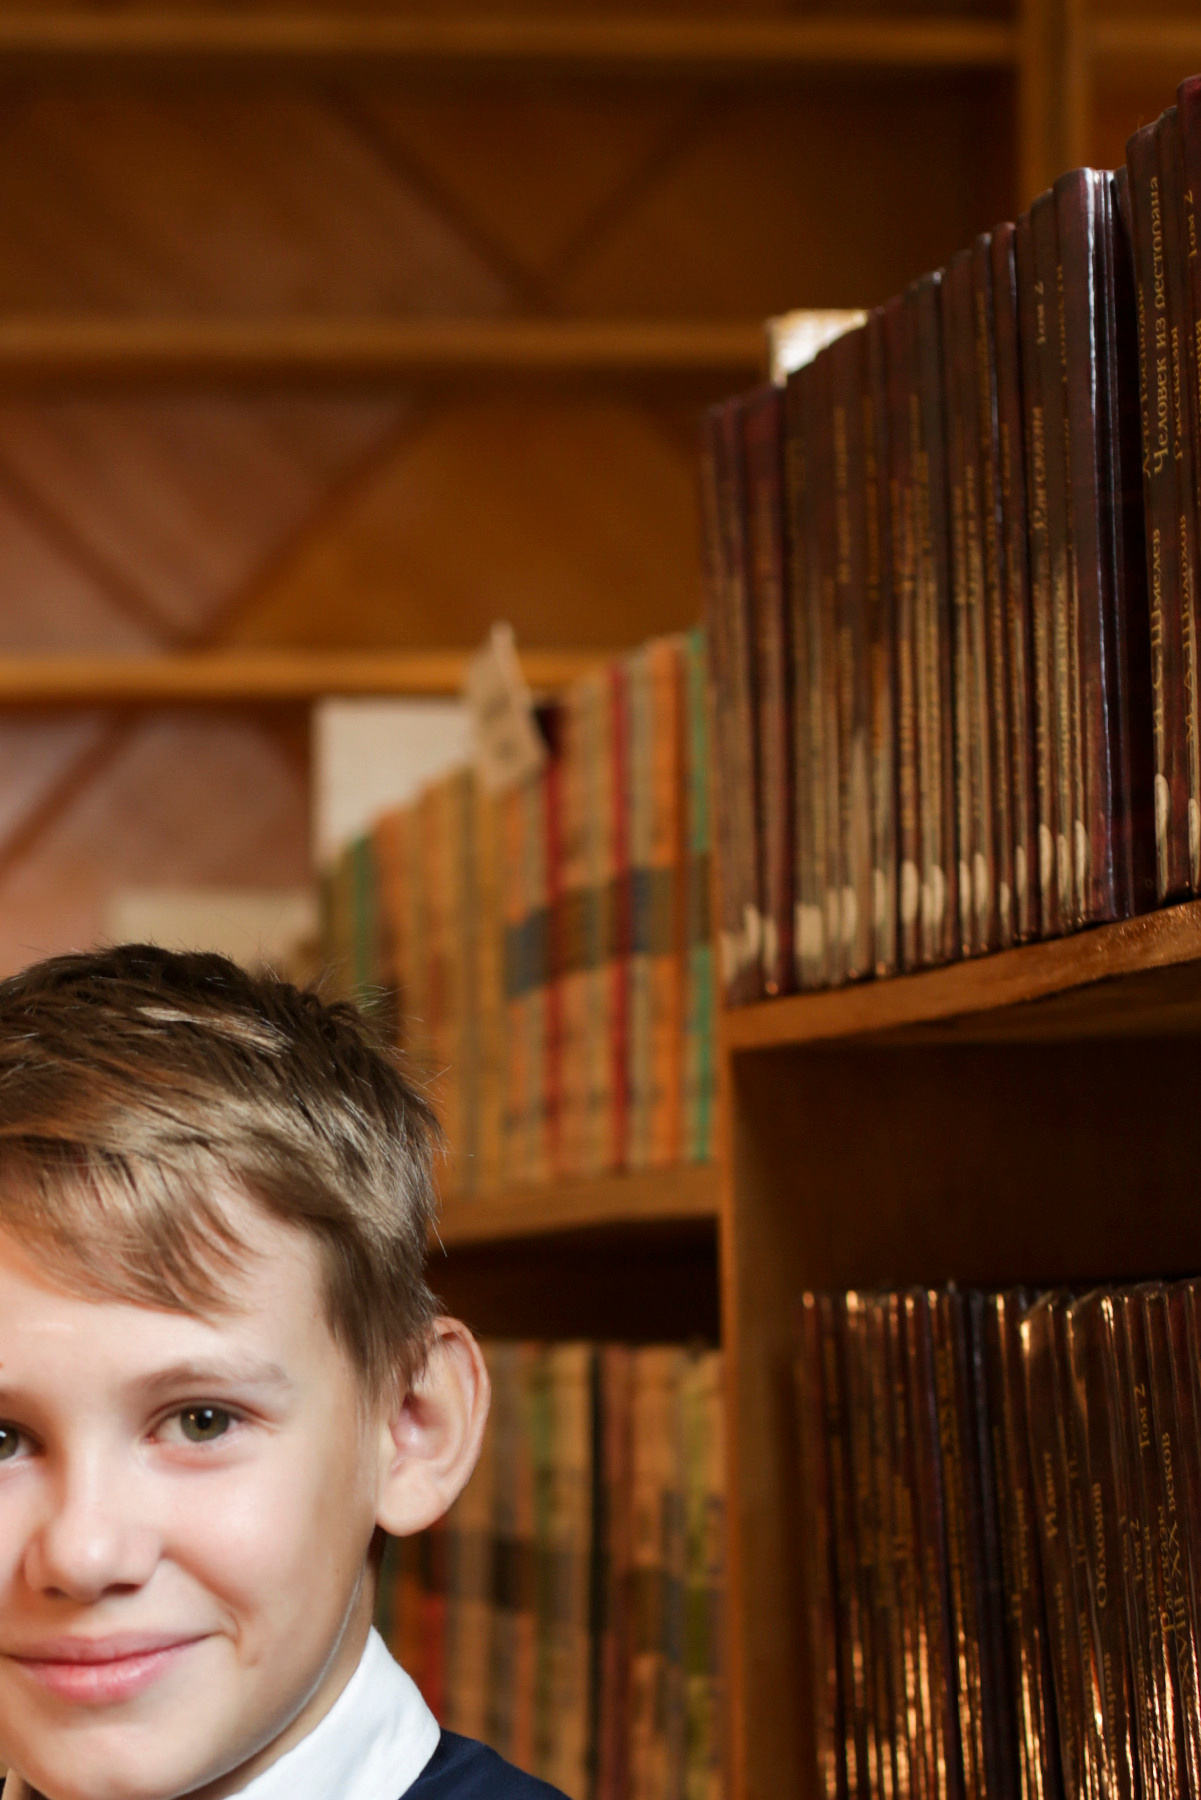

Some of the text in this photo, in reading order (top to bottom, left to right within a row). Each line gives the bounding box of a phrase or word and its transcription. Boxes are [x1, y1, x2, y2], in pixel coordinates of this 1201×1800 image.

[1155, 316, 1167, 347] из
[1153, 357, 1169, 473] Человек
[1150, 529, 1164, 647] Шмелев
[1179, 514, 1194, 653] Шолохов
[1134, 1382, 1152, 1457] Том 2
[1161, 1431, 1177, 1512] веков
[1091, 1481, 1109, 1609] Обломов
